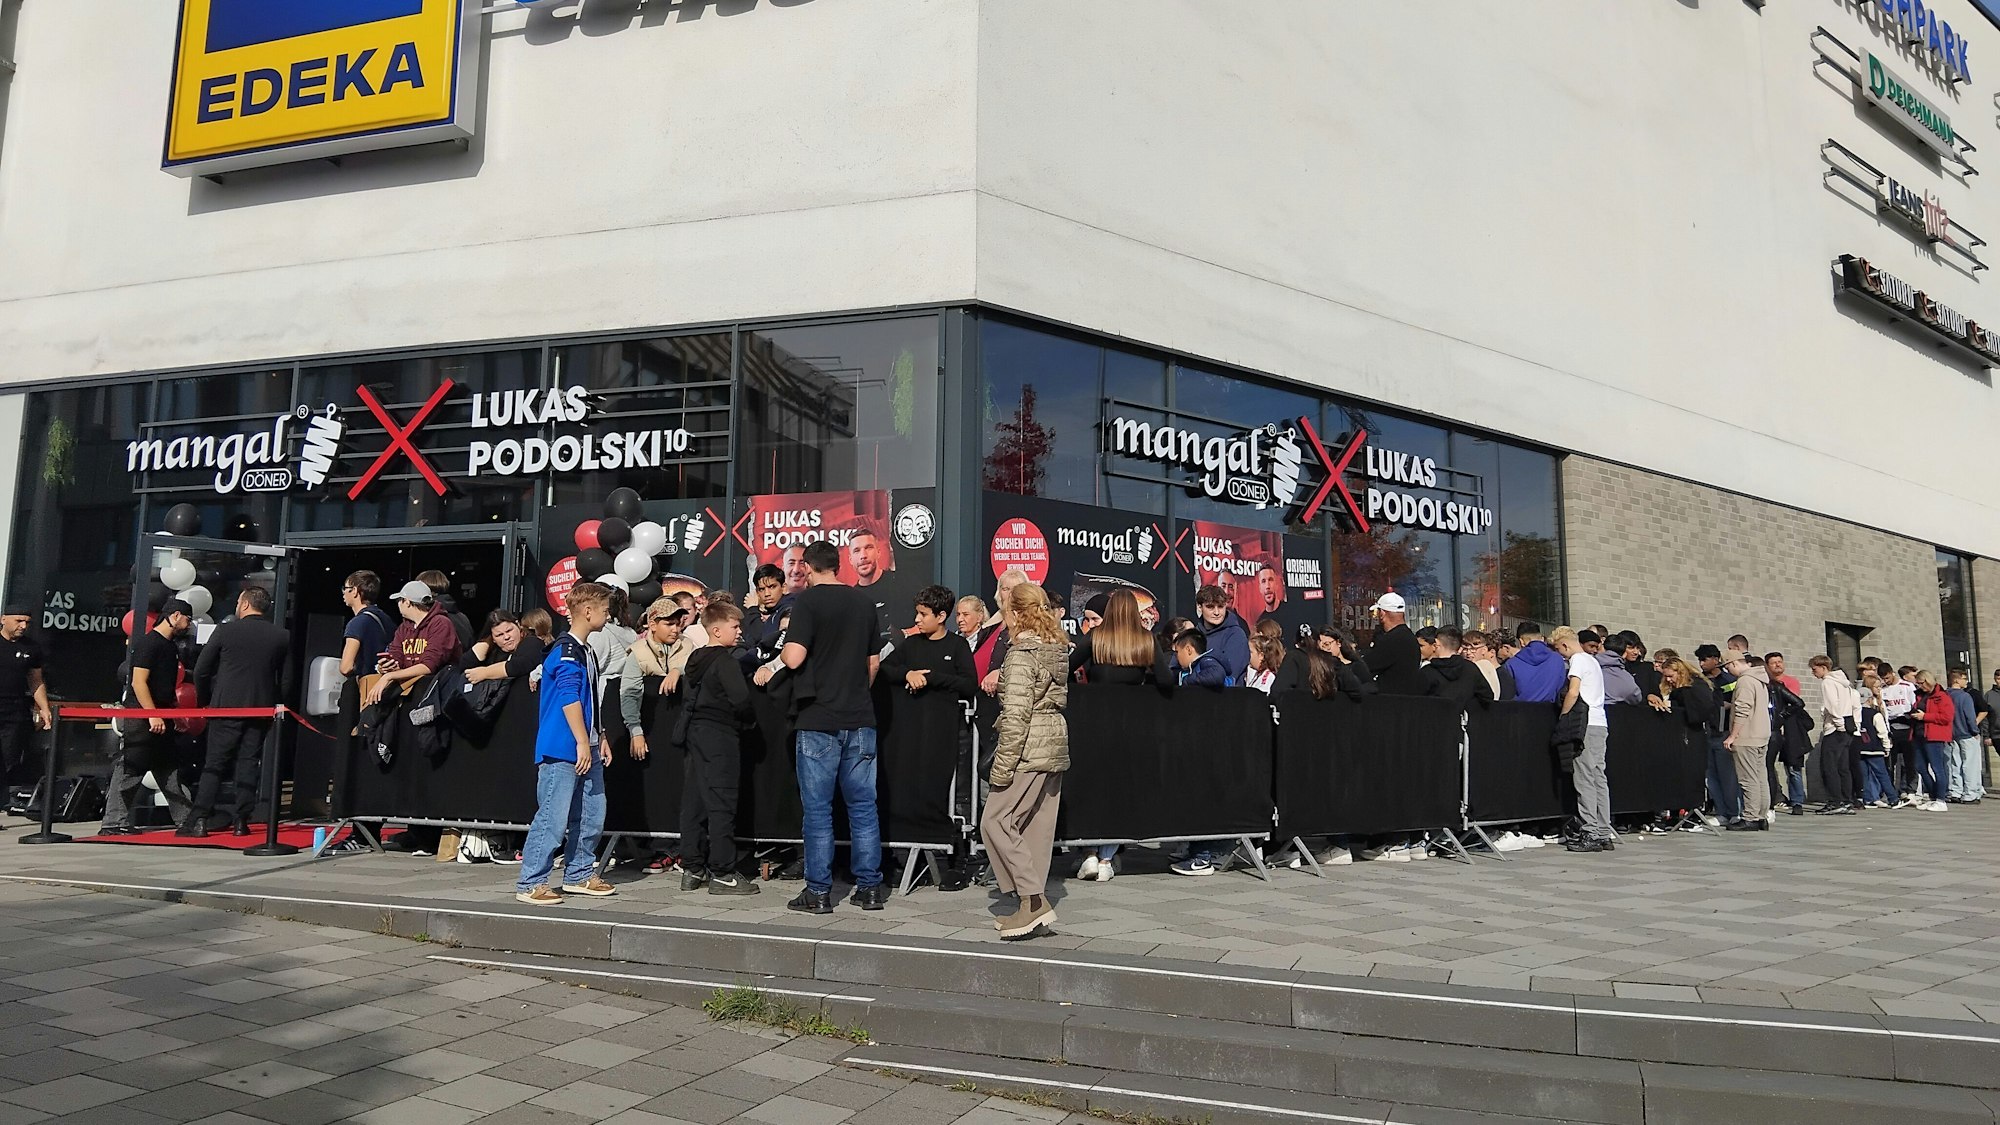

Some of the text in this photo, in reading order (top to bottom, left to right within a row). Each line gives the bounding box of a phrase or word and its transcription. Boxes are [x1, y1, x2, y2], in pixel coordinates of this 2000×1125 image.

[197, 41, 425, 124] EDEKA
[1886, 77, 1955, 147] DEICHMANN
[1888, 176, 1925, 219] JEANS
[1879, 270, 1915, 309] SATURN
[1936, 302, 1967, 338] SATURN
[471, 385, 588, 428] LUKAS
[126, 414, 293, 494] mangal
[1113, 416, 1264, 497] mangal
[1366, 445, 1437, 488] LUKAS
[246, 471, 287, 488] DÖNER
[1231, 480, 1266, 500] DÖNER
[764, 509, 821, 529] LUKAS
[1011, 522, 1026, 535] WIR
[995, 537, 1044, 550] SUCHEN DICH!
[1057, 527, 1133, 564] mangal
[1194, 535, 1232, 555] LUKAS
[1113, 552, 1133, 562] DÖNER
[1286, 558, 1321, 574] ORIGINAL
[549, 571, 575, 585] SUCHEN
[1287, 573, 1321, 588] MANGAL!
